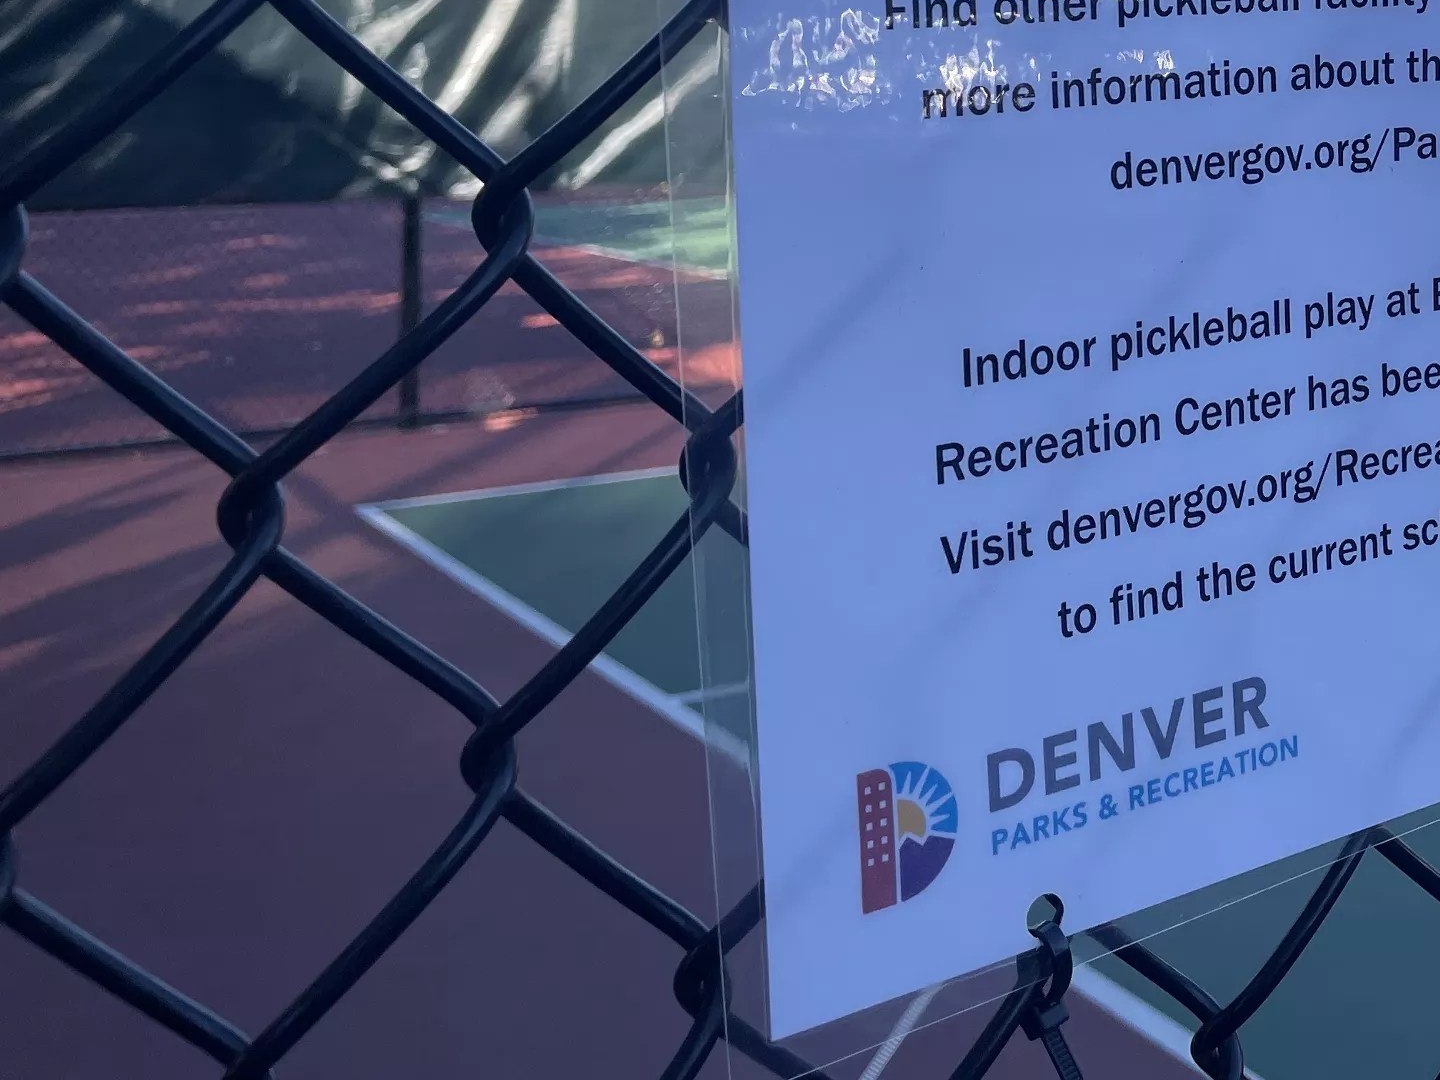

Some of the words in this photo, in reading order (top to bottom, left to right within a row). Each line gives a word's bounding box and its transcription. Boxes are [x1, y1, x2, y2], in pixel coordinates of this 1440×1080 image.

[923, 83, 1035, 119] more
[1052, 63, 1276, 109] information
[1291, 52, 1394, 91] about
[963, 336, 1096, 388] Indoor
[1111, 298, 1291, 371] pickleball
[1305, 292, 1375, 338] play
[1387, 283, 1420, 317] at
[936, 414, 1160, 485] Recreation
[1175, 387, 1296, 435] Center
[1308, 375, 1369, 411] has
[940, 521, 1033, 574] Visit
[1058, 601, 1096, 638] to
[1110, 575, 1183, 625] find
[1196, 562, 1256, 602] the
[1269, 523, 1392, 583] current
[987, 677, 1269, 813] DENVER
[992, 806, 1087, 855] PARKS
[1099, 794, 1118, 819] &
[1128, 735, 1298, 807] RECREATION
